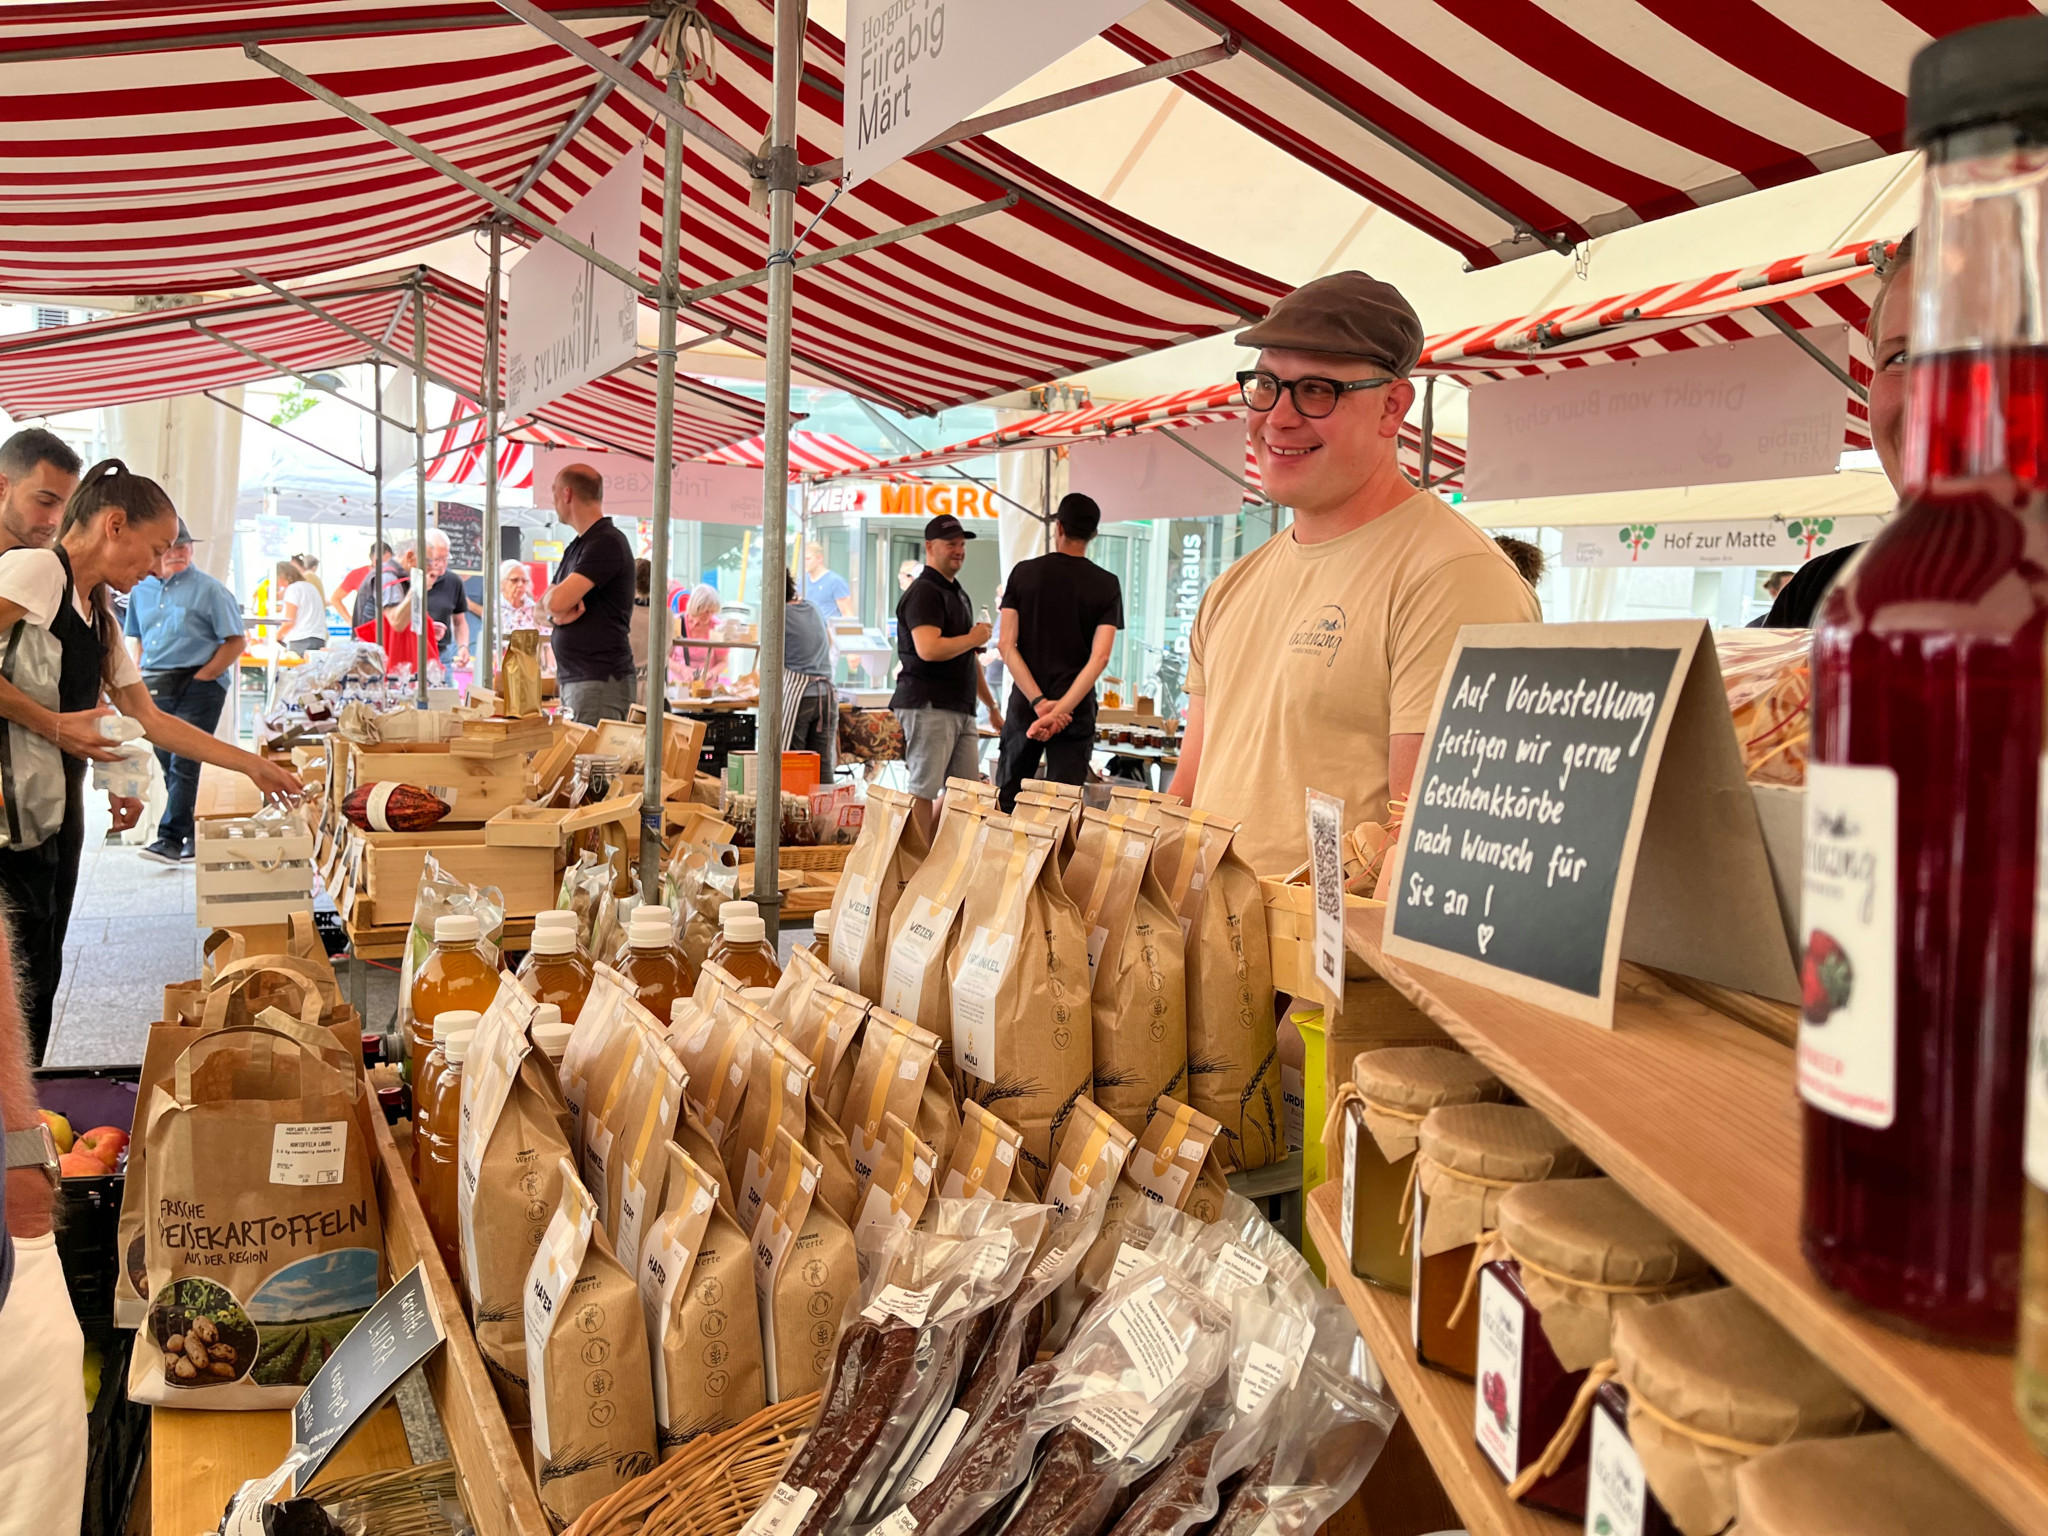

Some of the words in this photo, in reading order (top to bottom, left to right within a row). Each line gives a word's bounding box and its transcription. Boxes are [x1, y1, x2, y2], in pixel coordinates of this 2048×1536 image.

[858, 73, 912, 151] Märt
[1664, 532, 1693, 549] Hof
[1695, 536, 1720, 549] zur
[1727, 531, 1776, 549] Matte
[1174, 533, 1202, 654] Parkhaus
[1452, 672, 1496, 712] Auf
[1505, 674, 1655, 757] Vorbestellung
[1435, 725, 1508, 778] fertigen
[1515, 734, 1552, 764] wir
[1559, 743, 1621, 791] gerne
[1424, 774, 1565, 824] Geschenkkörbe
[1414, 823, 1451, 856] nach
[1461, 829, 1533, 874] Wunsch
[1547, 844, 1587, 888] für
[1407, 871, 1435, 906] Sie
[1443, 889, 1469, 916] an
[909, 921, 935, 942] WEIZEN
[855, 1159, 872, 1180] ZOPF
[160, 1199, 206, 1219] FRISCHE
[623, 1198, 635, 1222] ZOPF
[748, 1186, 761, 1208] ZOPF
[184, 1252, 201, 1265] AUS
[205, 1253, 227, 1266] DER
[229, 1250, 269, 1264] REGION
[757, 1241, 773, 1269] HAFER
[795, 1238, 824, 1251] Werte
[571, 1281, 602, 1295] Werte
[647, 1253, 666, 1288] HAFER
[398, 1289, 427, 1340] Kartoffel
[534, 1278, 552, 1316] HAFER
[368, 1312, 397, 1375] LAURA
